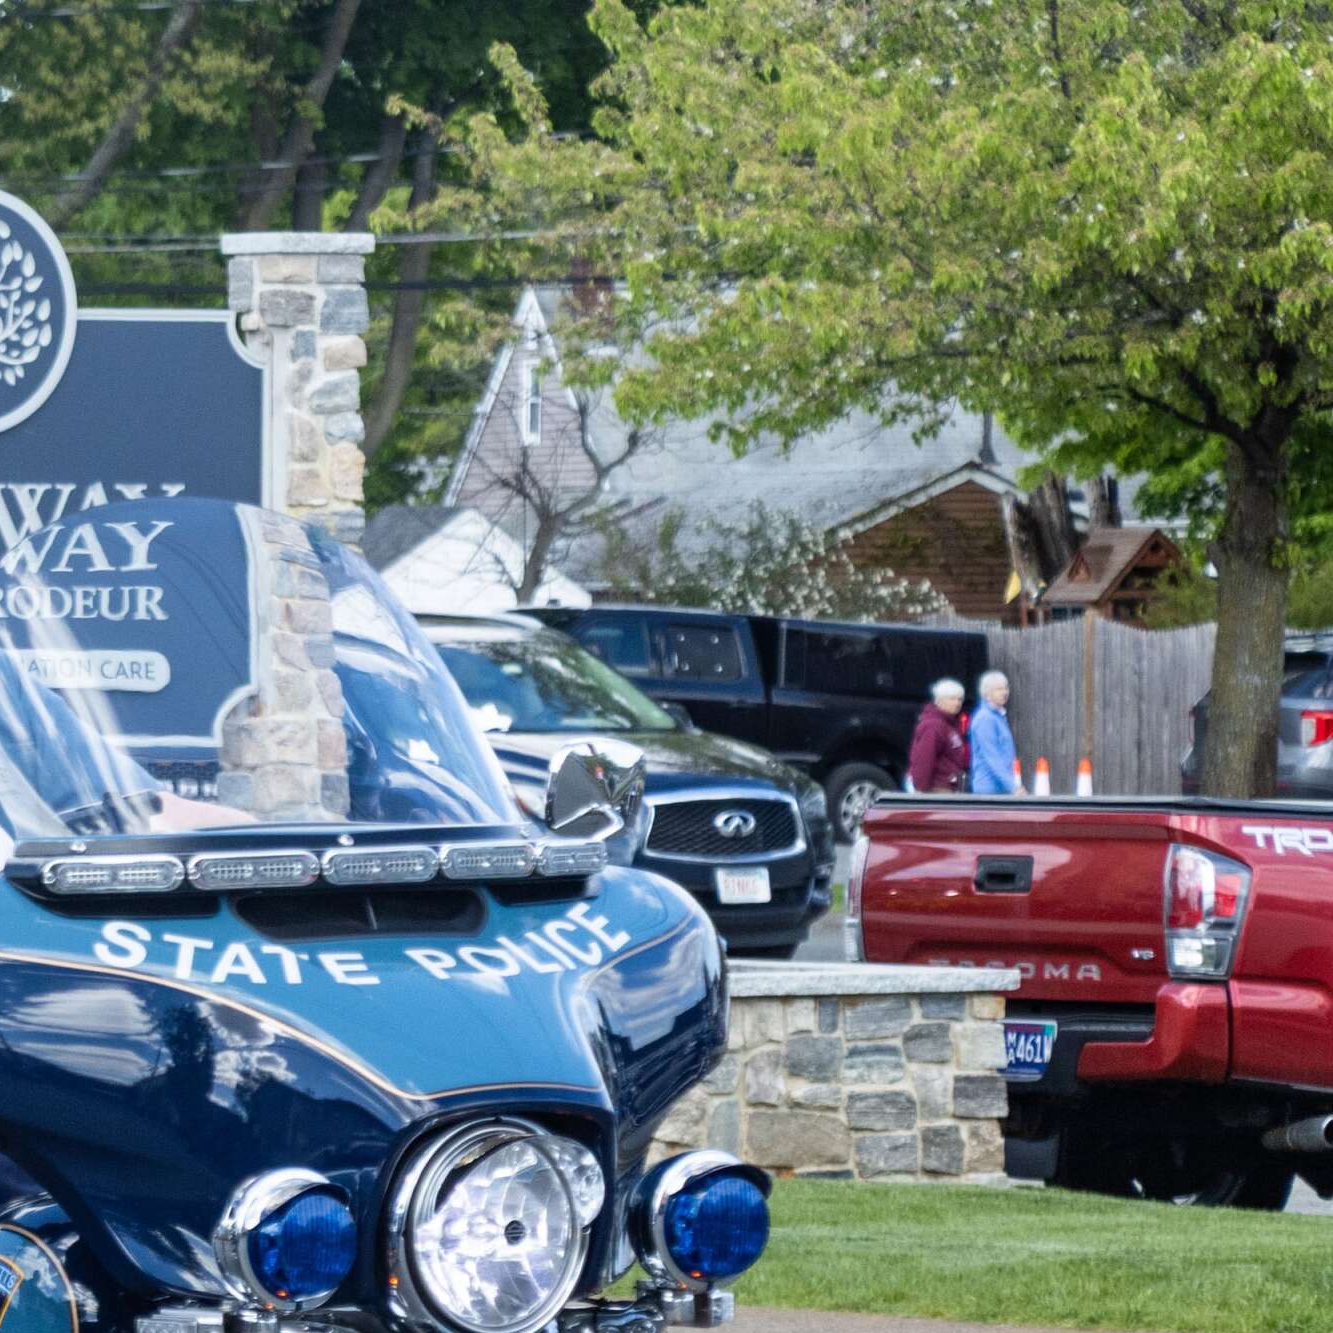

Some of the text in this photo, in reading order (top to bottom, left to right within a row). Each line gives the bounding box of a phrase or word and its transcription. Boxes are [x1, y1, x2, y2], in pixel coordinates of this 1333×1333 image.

[99, 659, 157, 681] CARE
[1241, 826, 1333, 857] TRD
[93, 901, 632, 986] STATE POLICE
